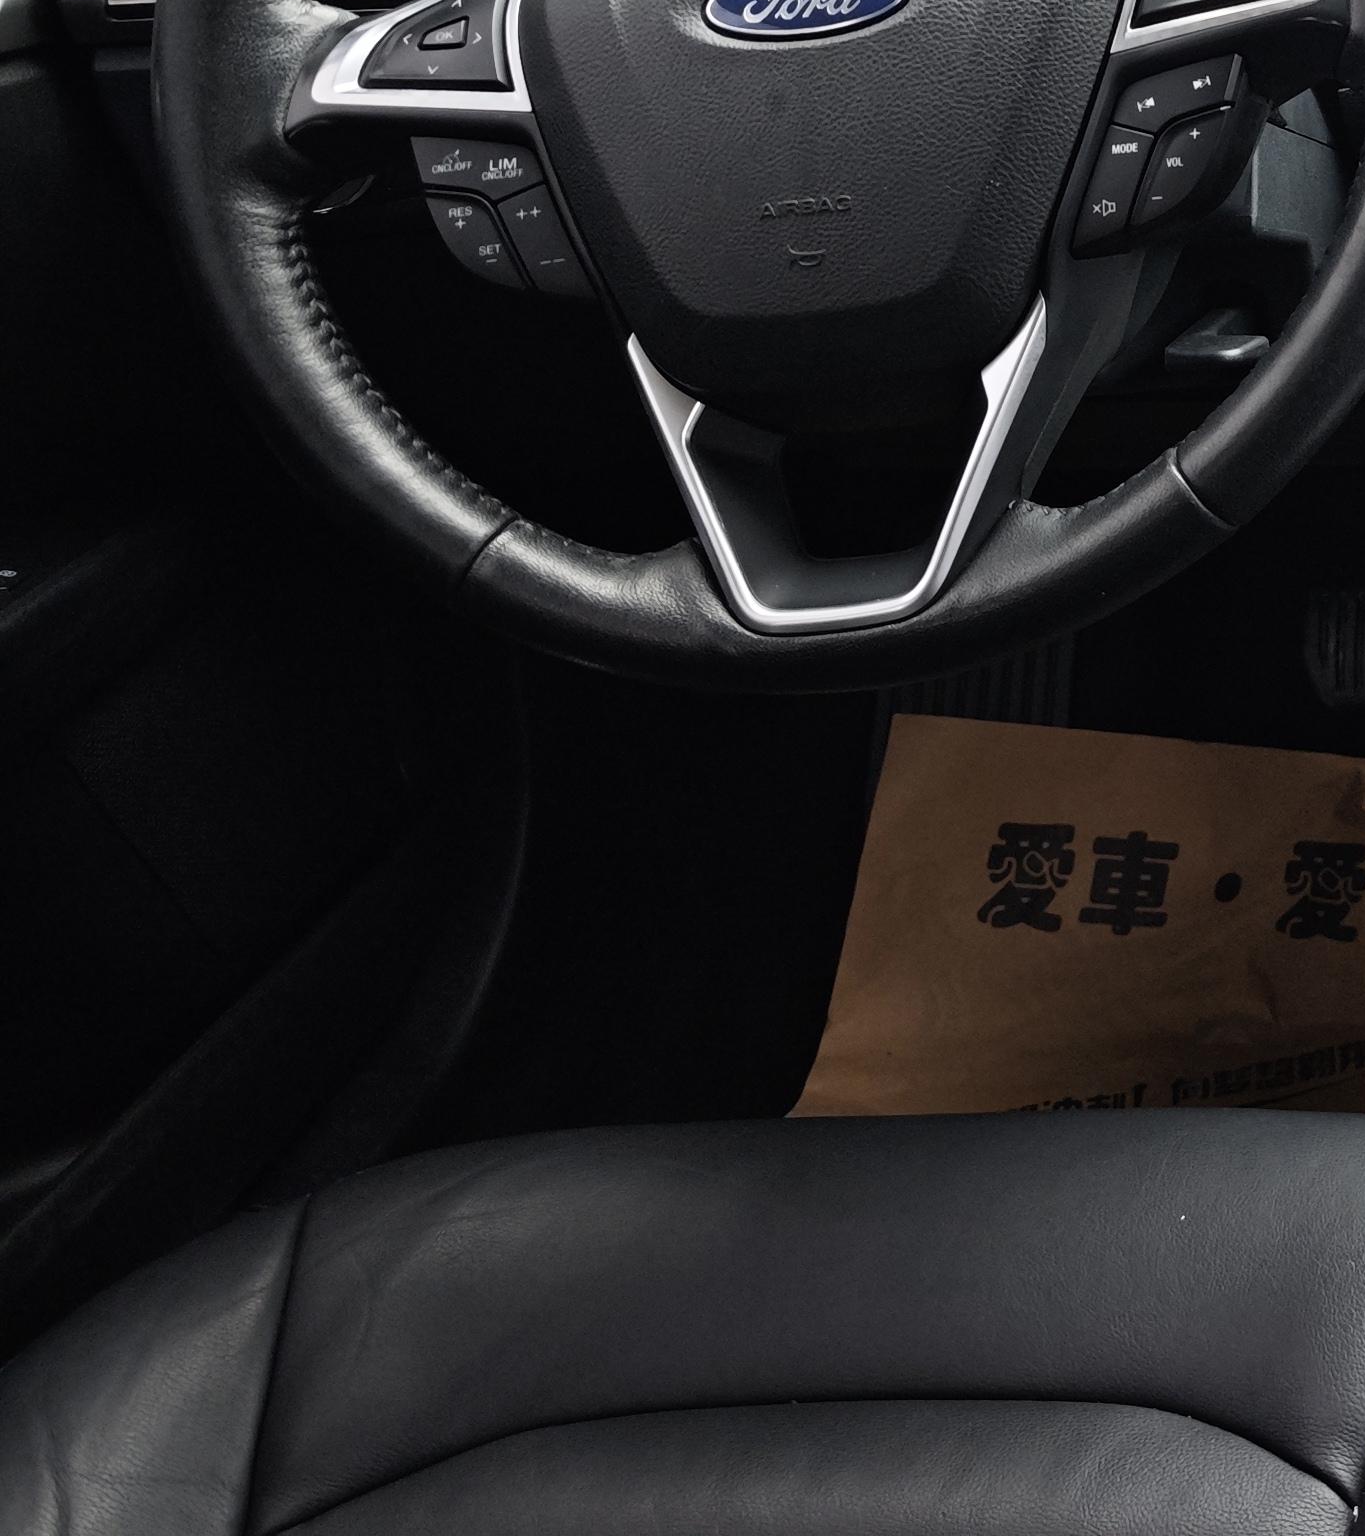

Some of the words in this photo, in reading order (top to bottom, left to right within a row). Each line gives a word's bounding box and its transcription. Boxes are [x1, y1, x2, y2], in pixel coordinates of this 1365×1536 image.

[435, 30, 453, 41] OK
[1111, 142, 1139, 155] MODE
[489, 157, 518, 171] LIM
[1166, 156, 1184, 168] VOL
[448, 205, 473, 218] RES
[478, 243, 501, 256] SET
